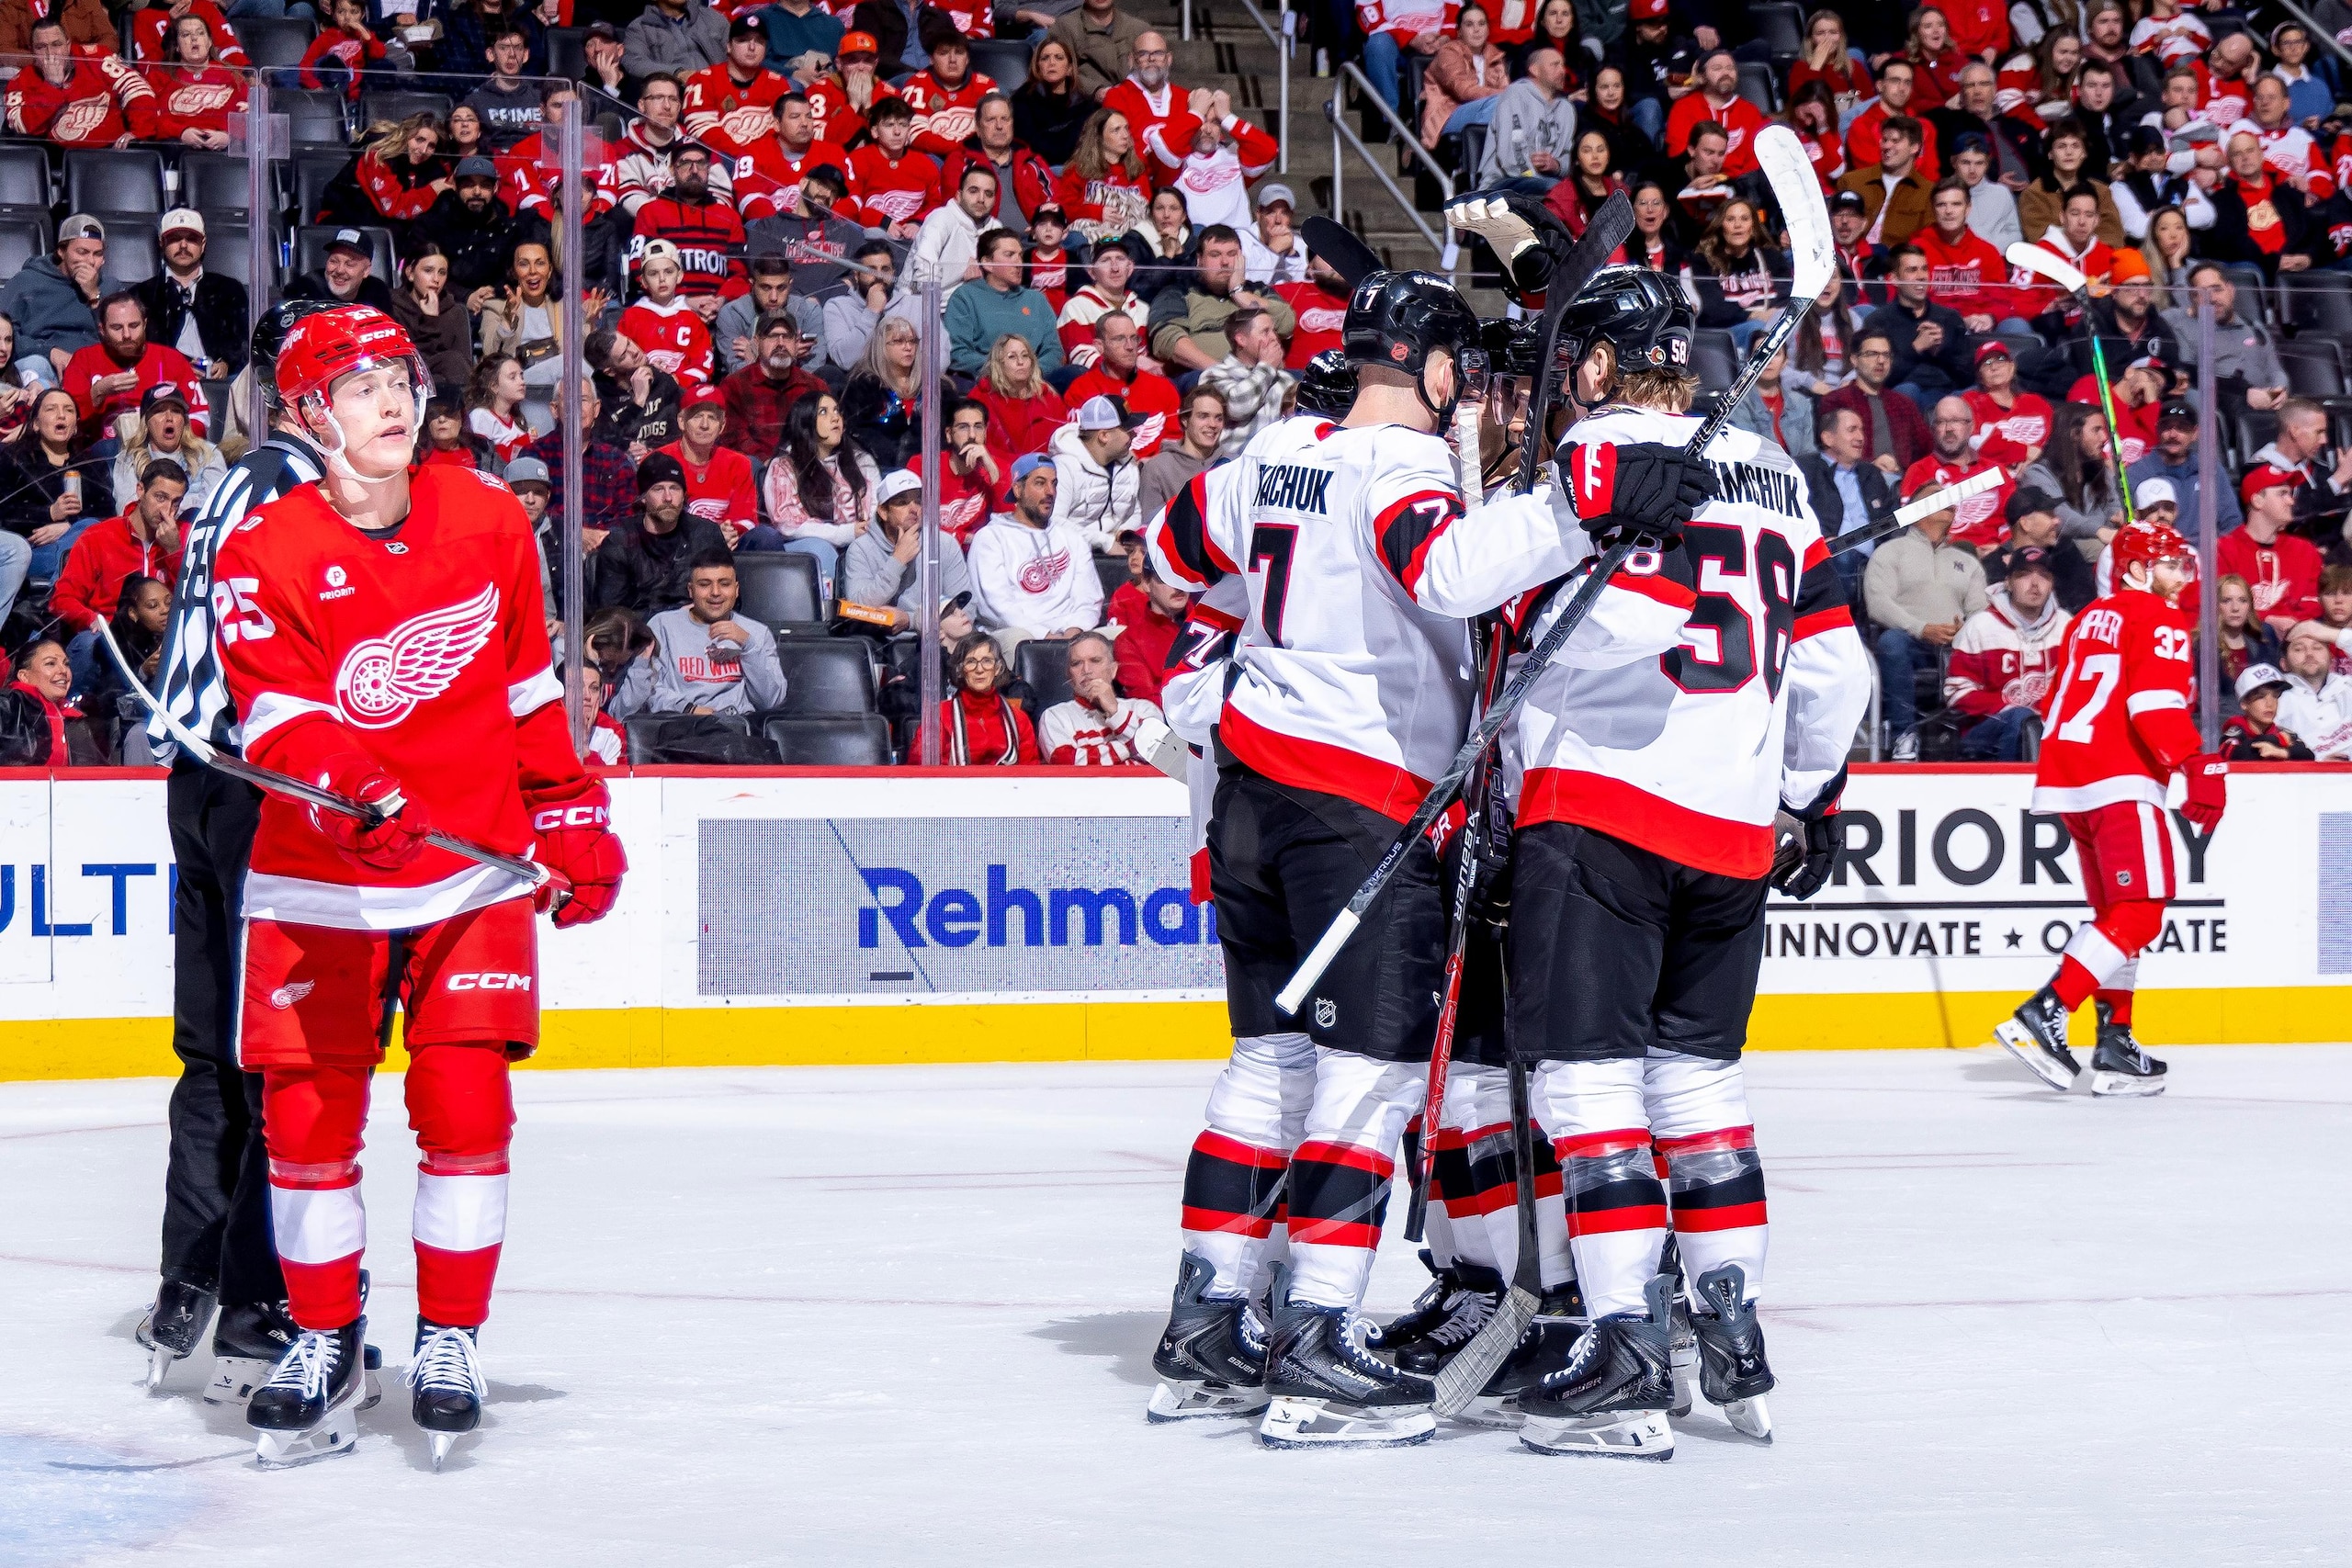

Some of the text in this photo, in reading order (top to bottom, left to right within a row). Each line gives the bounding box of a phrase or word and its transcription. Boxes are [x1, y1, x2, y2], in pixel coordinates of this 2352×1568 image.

[900, 85, 926, 108] 71
[677, 248, 728, 277] TROIT
[278, 327, 306, 355] eijer
[359, 329, 396, 344] CCM
[676, 326, 691, 346] C
[1670, 339, 1688, 365] 58
[1409, 495, 1451, 531] 7
[319, 586, 356, 601] PRIORITY
[1248, 522, 1301, 649] 7
[211, 577, 277, 649] 25
[1659, 520, 1796, 705] 58
[1505, 599, 1587, 698] SMOKE
[2153, 625, 2190, 662] 37
[679, 656, 705, 678] RED
[536, 805, 612, 831] CCM
[1453, 827, 1475, 921] BAUER
[1764, 919, 1982, 958] INNOVATE
[447, 972, 532, 992] CCM
[1227, 1356, 1257, 1375] BAUER
[1331, 1363, 1380, 1388] BAUER
[1561, 1376, 1603, 1399] BAUER
